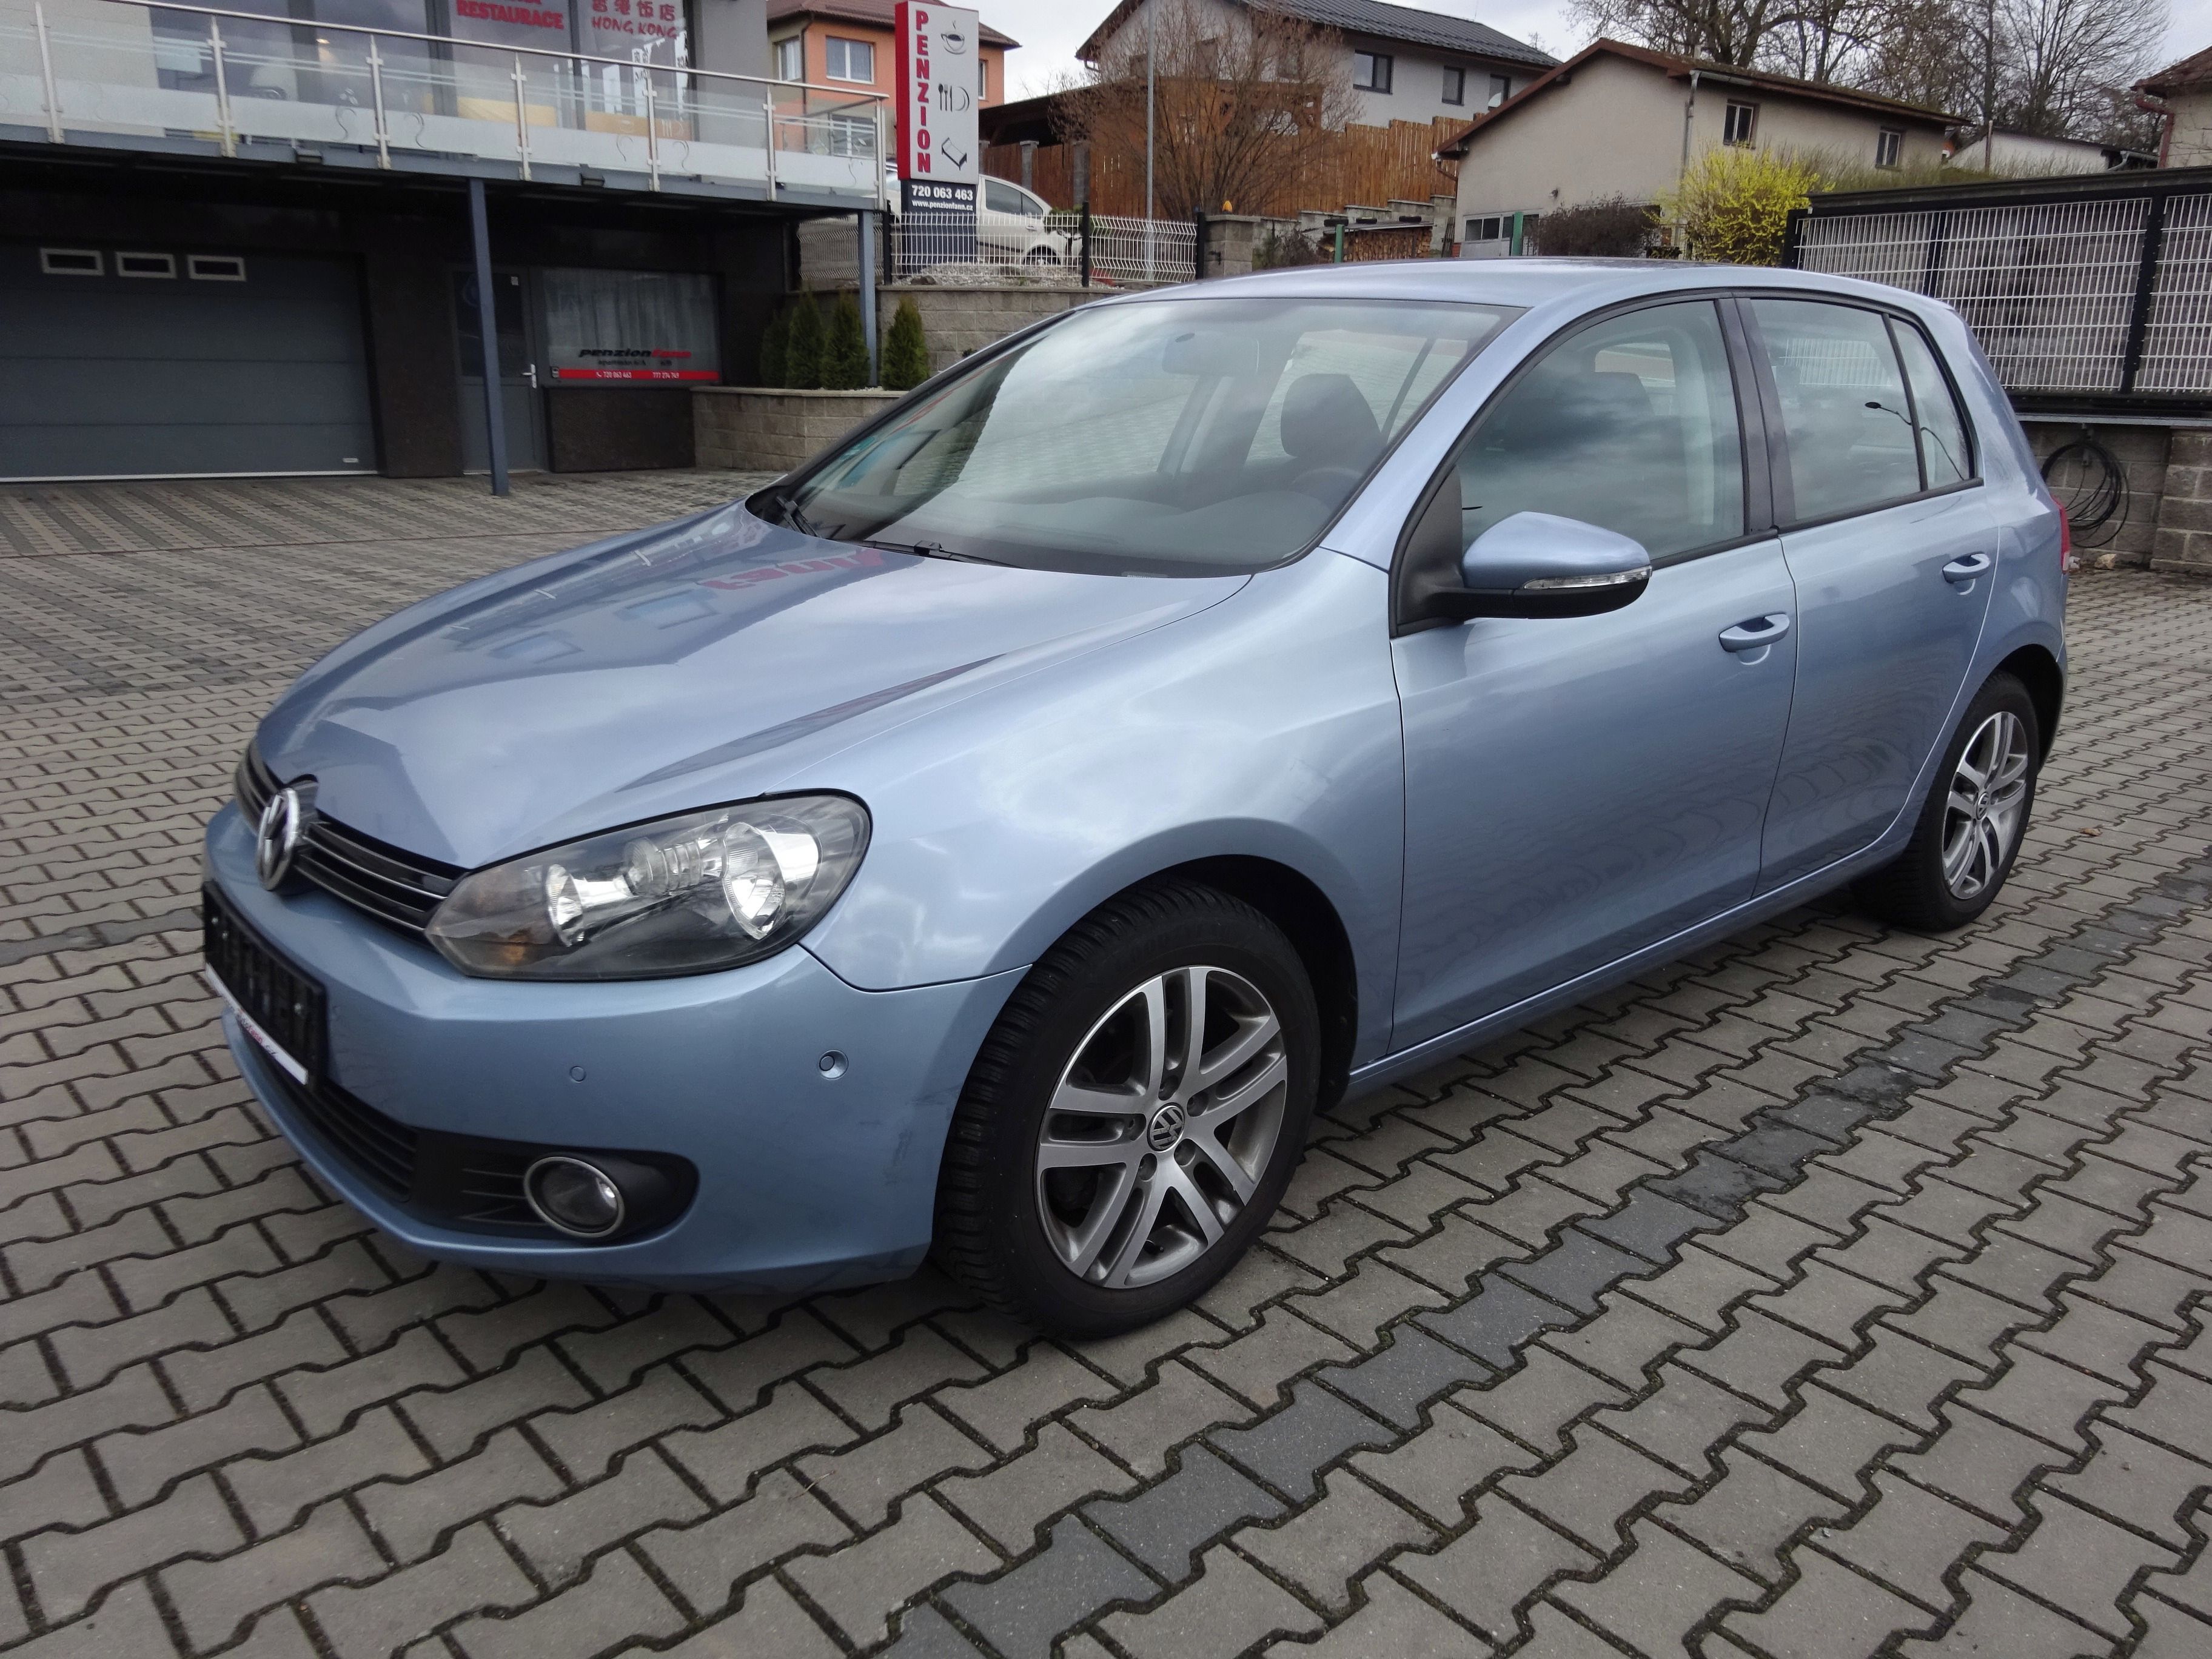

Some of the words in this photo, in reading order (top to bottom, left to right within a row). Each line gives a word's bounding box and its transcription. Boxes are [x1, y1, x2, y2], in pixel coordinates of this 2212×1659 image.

[457, 0, 565, 29] RESTAURACE
[591, 16, 634, 35] HONG
[638, 21, 677, 39] KONG
[916, 10, 931, 173] PENZION
[911, 184, 931, 197] 720
[933, 187, 952, 199] 063
[954, 189, 973, 201] 463
[911, 199, 973, 211] www.penzionfann.cz
